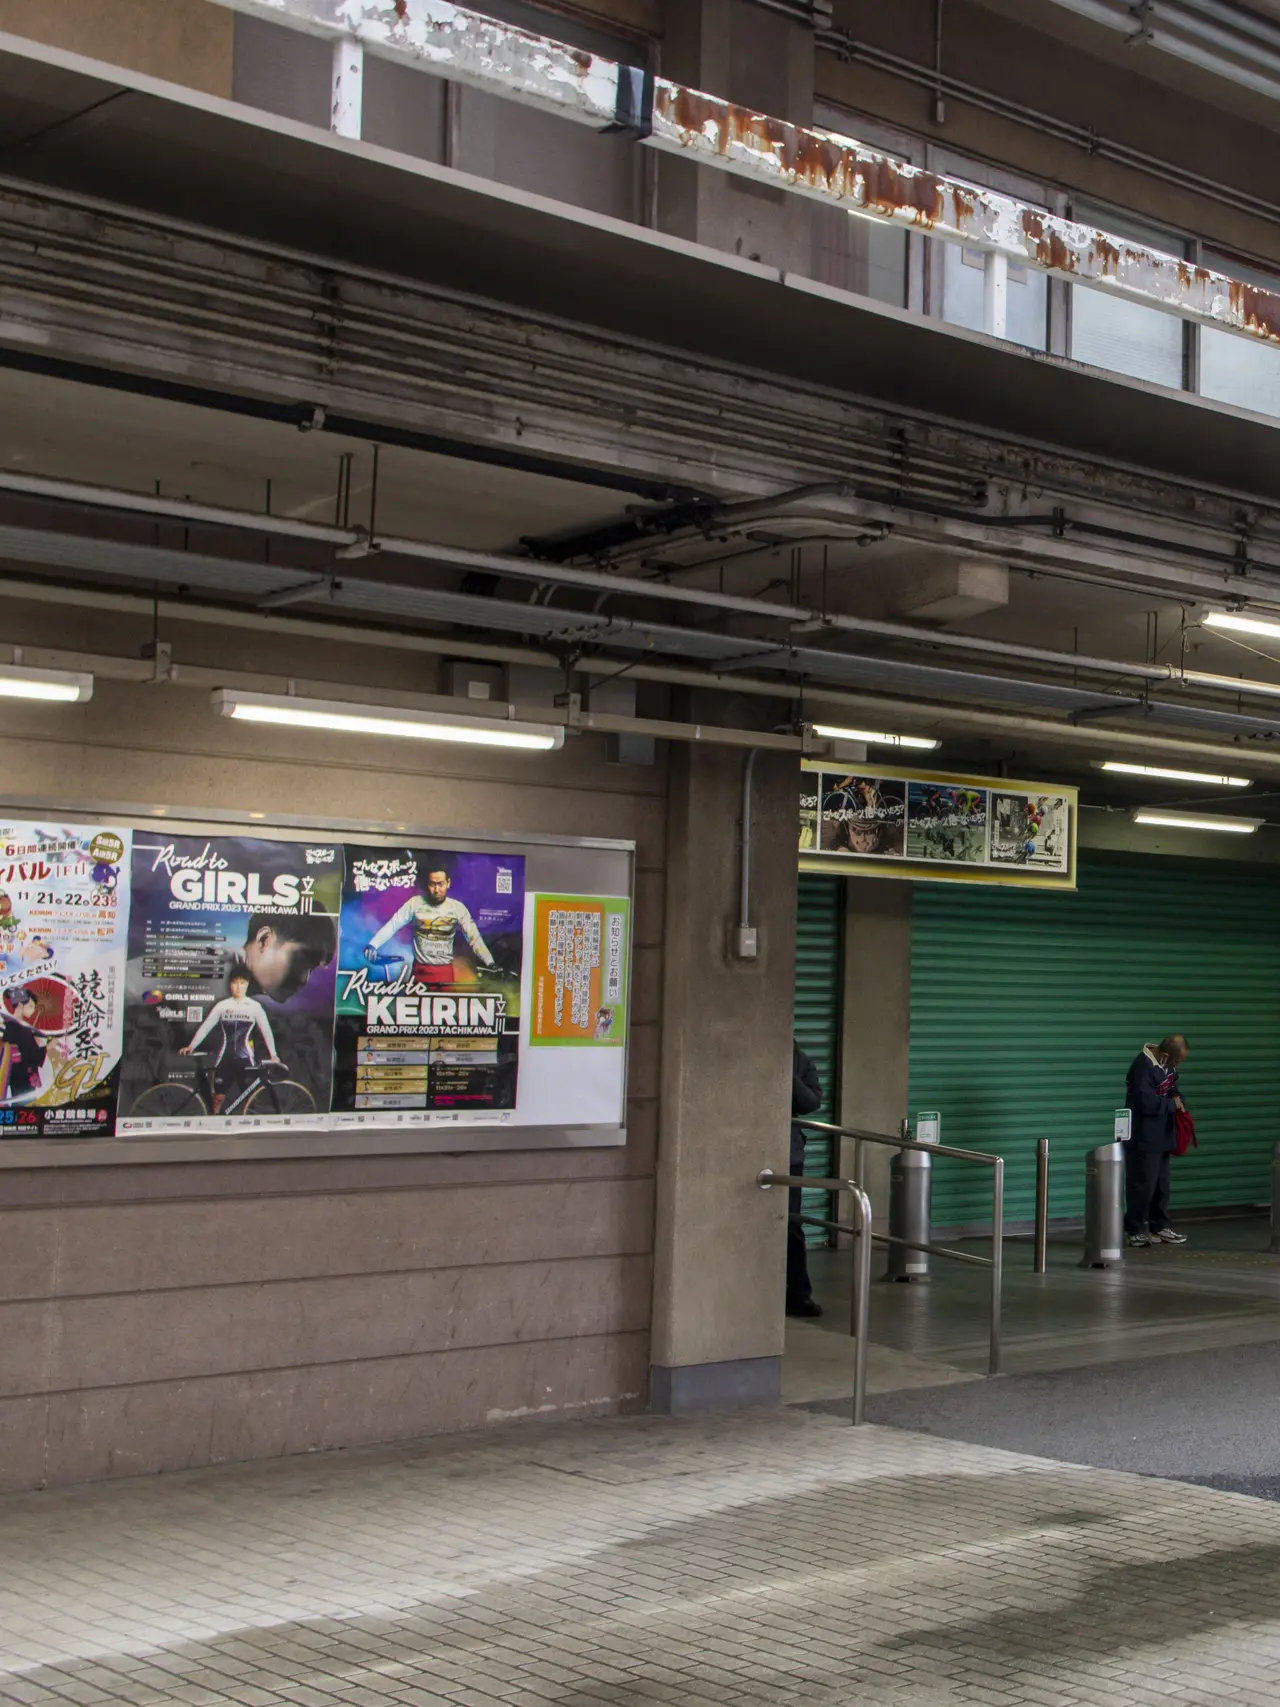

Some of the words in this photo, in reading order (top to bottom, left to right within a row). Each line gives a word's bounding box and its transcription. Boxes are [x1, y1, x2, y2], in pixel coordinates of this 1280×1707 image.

[152, 842, 210, 877] Road
[206, 851, 229, 870] to
[170, 869, 301, 906] GIRLS
[169, 900, 201, 911] GRAND
[201, 902, 220, 912] PRIX
[221, 903, 241, 913] 2023
[242, 904, 298, 915] TACHIKAWA
[608, 916, 621, 998] お知らせとお願い
[164, 993, 189, 1002] GIRLS
[189, 993, 215, 1002] KEIRIN
[342, 964, 408, 1005] Road
[404, 975, 428, 995] to
[70, 969, 107, 1060] 競輪祭
[367, 995, 496, 1026] KEIRIN
[367, 1025, 399, 1034] GRAND
[399, 1025, 418, 1034] PRIX
[418, 1025, 439, 1035] 2023
[440, 1025, 494, 1035] TACHIKAWA
